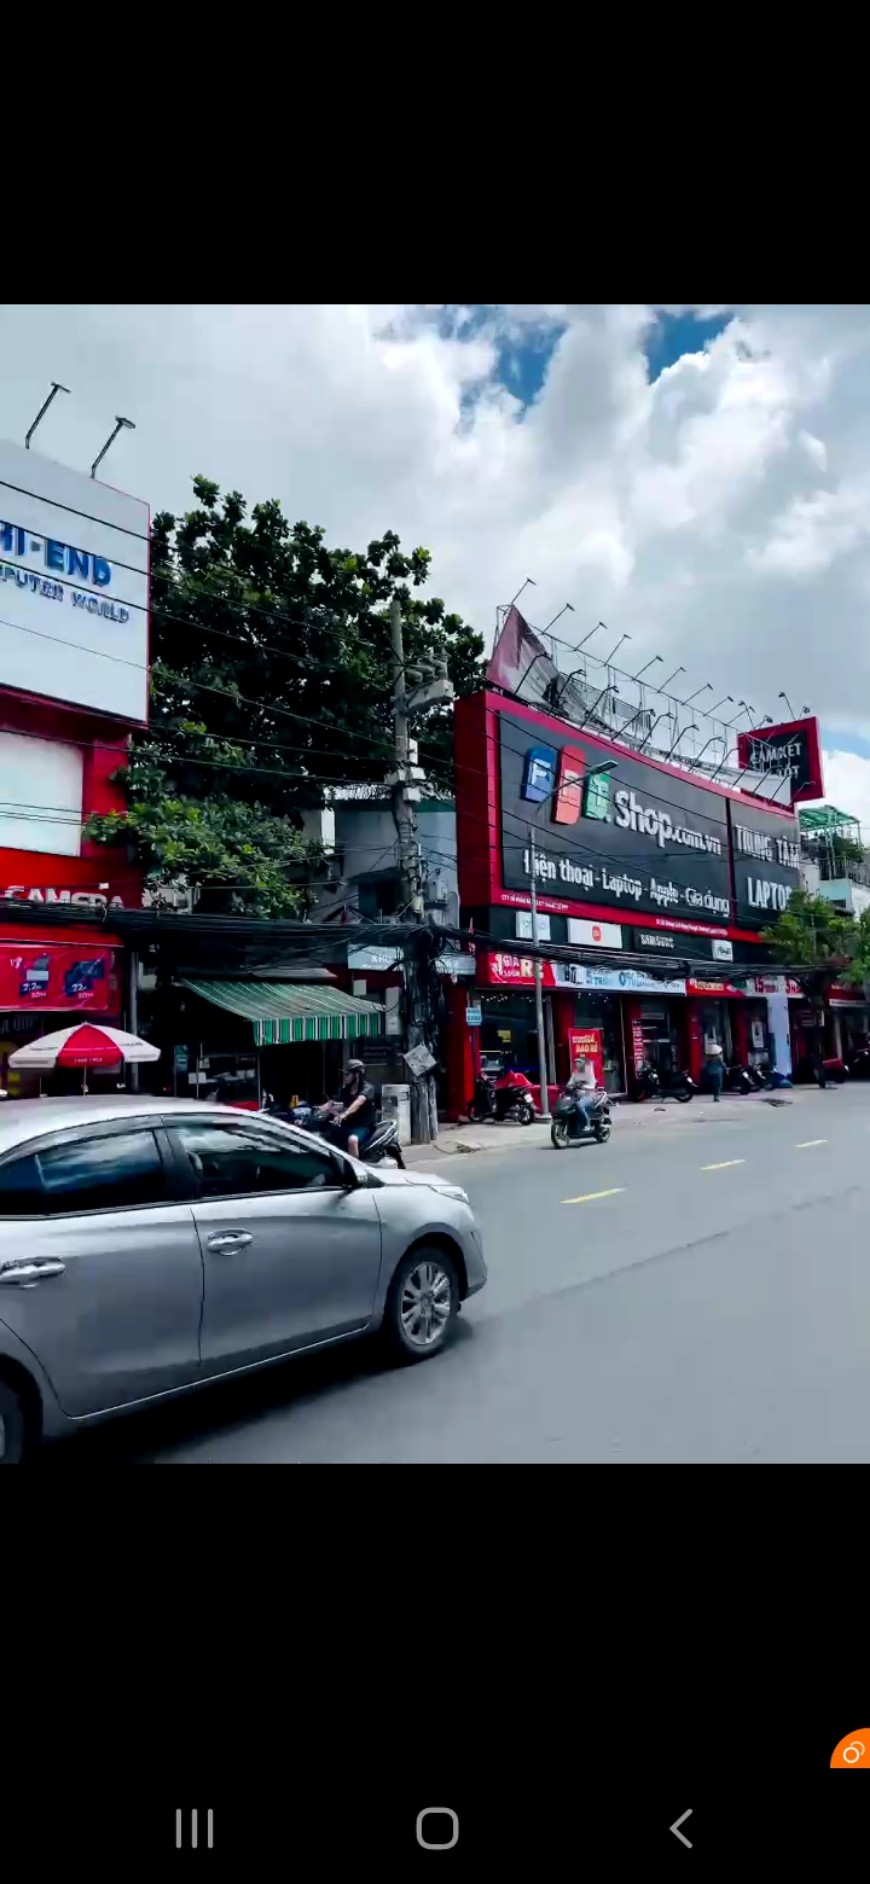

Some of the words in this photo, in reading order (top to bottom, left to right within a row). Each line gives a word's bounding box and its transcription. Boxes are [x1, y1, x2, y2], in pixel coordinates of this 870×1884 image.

[0, 565, 64, 602] PUTER
[72, 592, 129, 623] WORLD
[559, 859, 594, 891] thoại
[602, 868, 642, 901] Laptop
[650, 878, 678, 907] Apple
[640, 934, 675, 949] SAMSUNG
